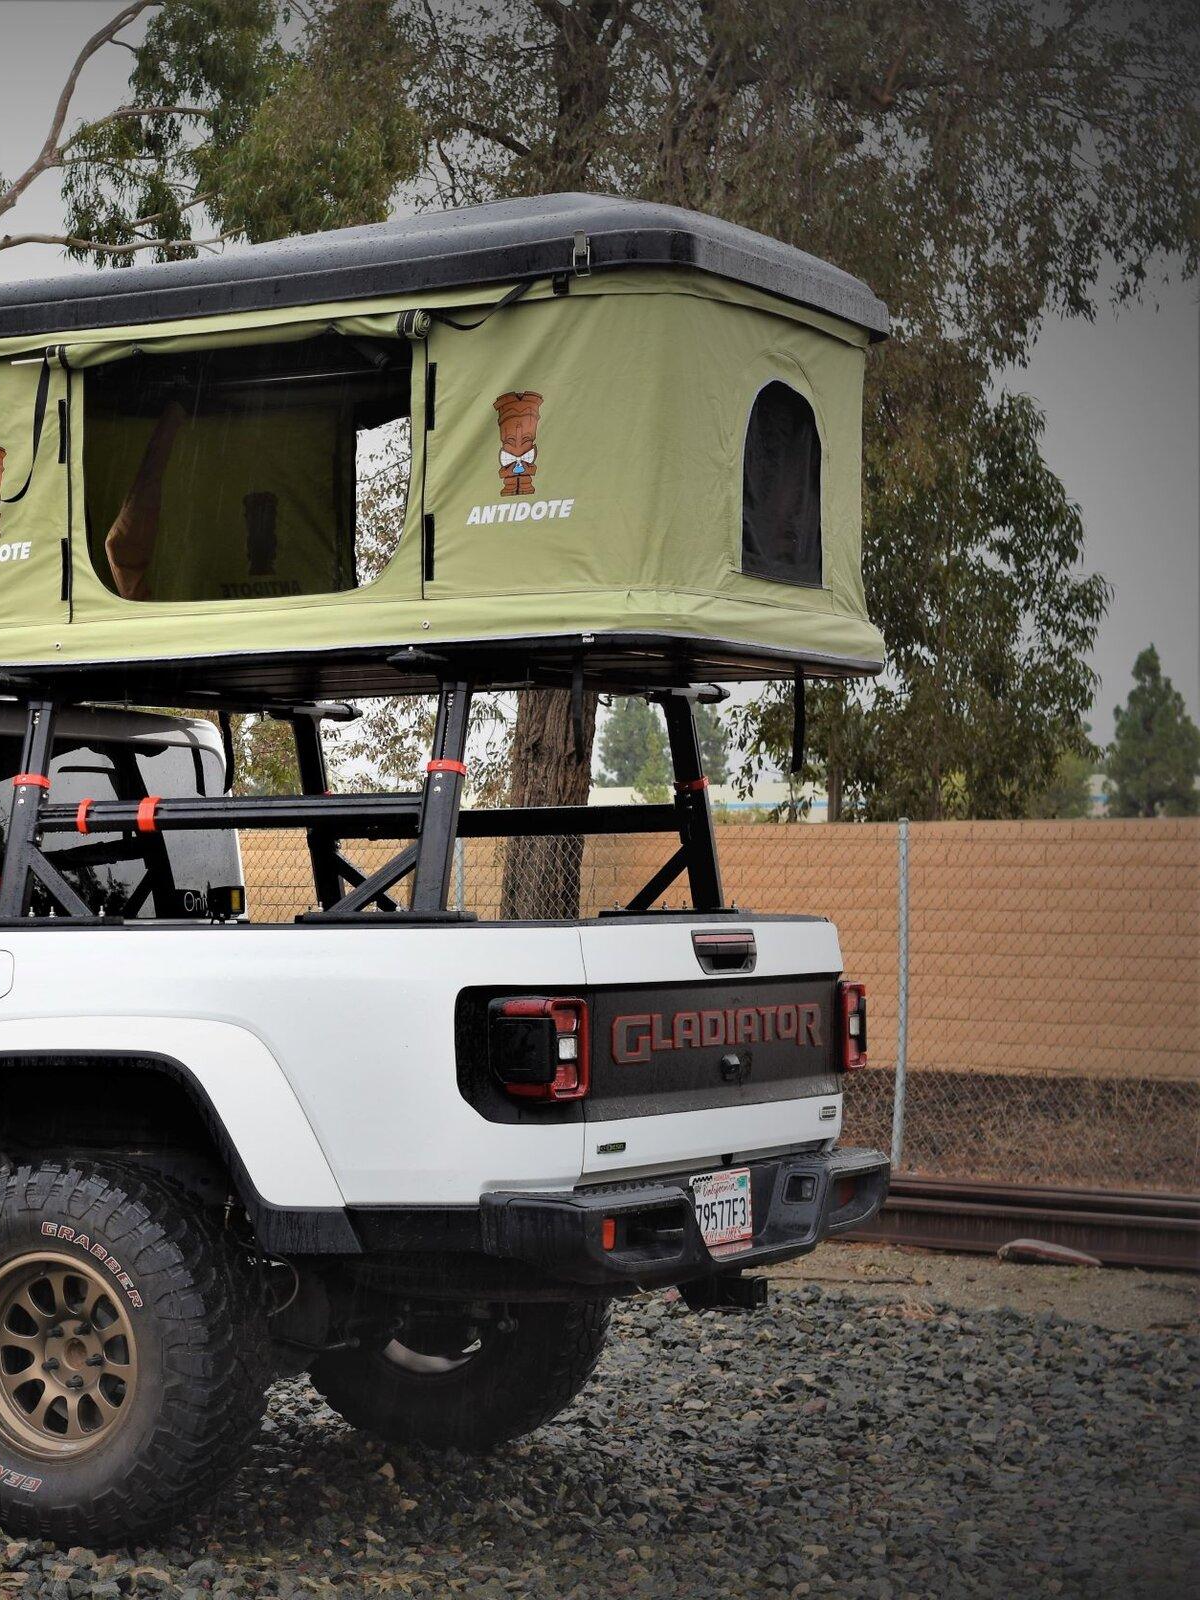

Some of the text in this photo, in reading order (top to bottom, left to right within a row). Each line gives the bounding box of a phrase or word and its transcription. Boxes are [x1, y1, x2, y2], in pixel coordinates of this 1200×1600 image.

[466, 498, 575, 526] ANTIDOTE
[611, 1002, 824, 1065] GLADIATOR
[40, 1220, 144, 1308] GRABBER
